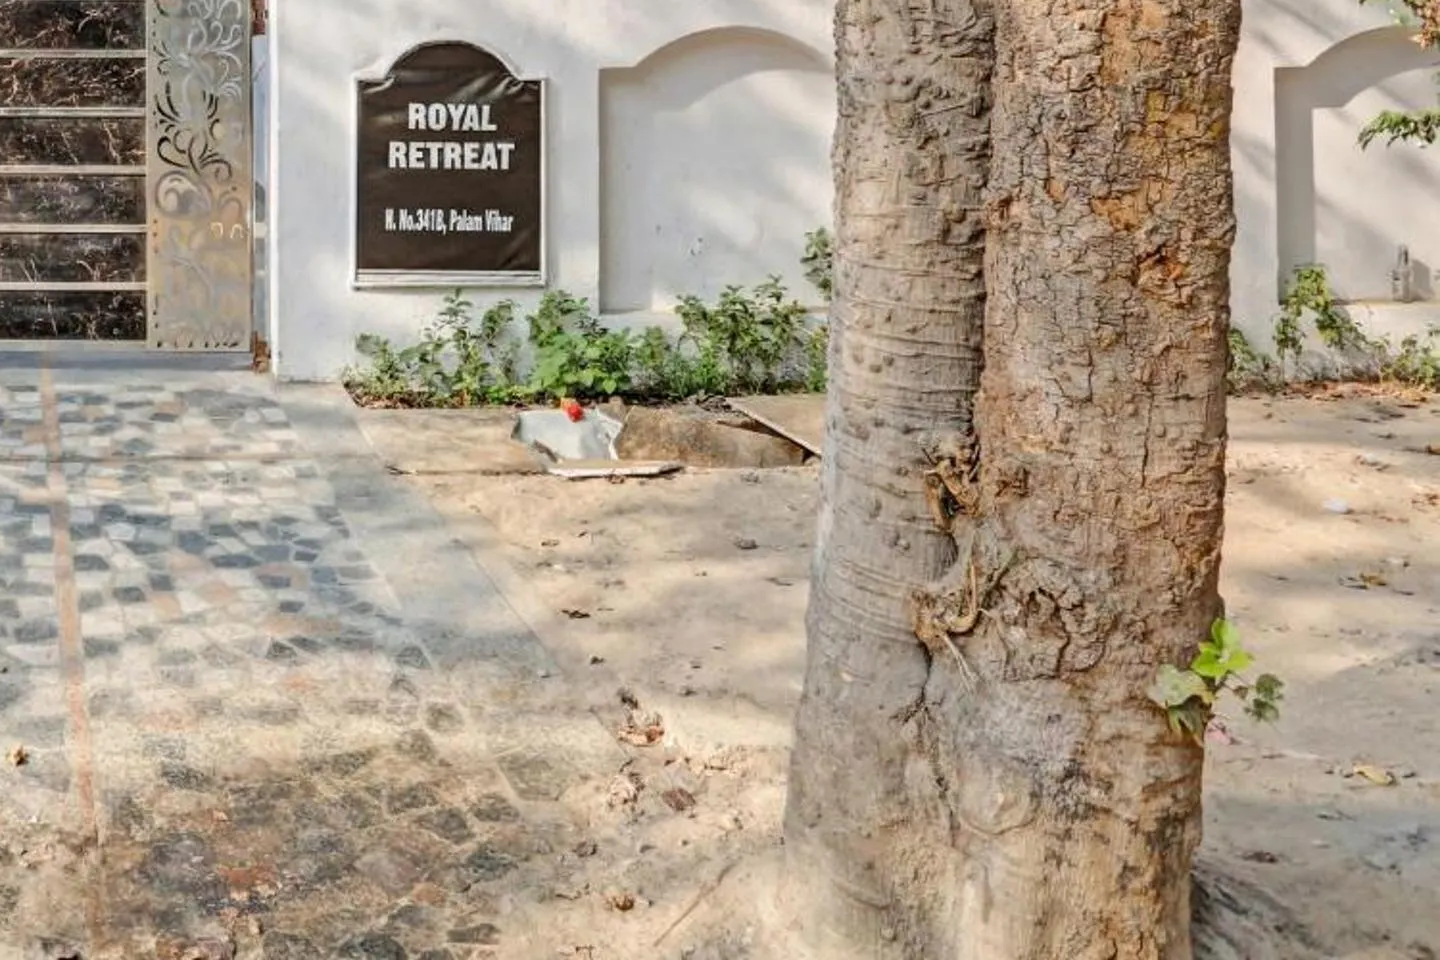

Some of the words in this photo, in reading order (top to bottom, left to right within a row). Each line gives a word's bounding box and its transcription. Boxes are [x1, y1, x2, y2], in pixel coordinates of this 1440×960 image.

[408, 102, 498, 132] ROYAL
[388, 141, 515, 171] RETREAT
[448, 209, 482, 232] Palam
[485, 209, 514, 232] Vihar
